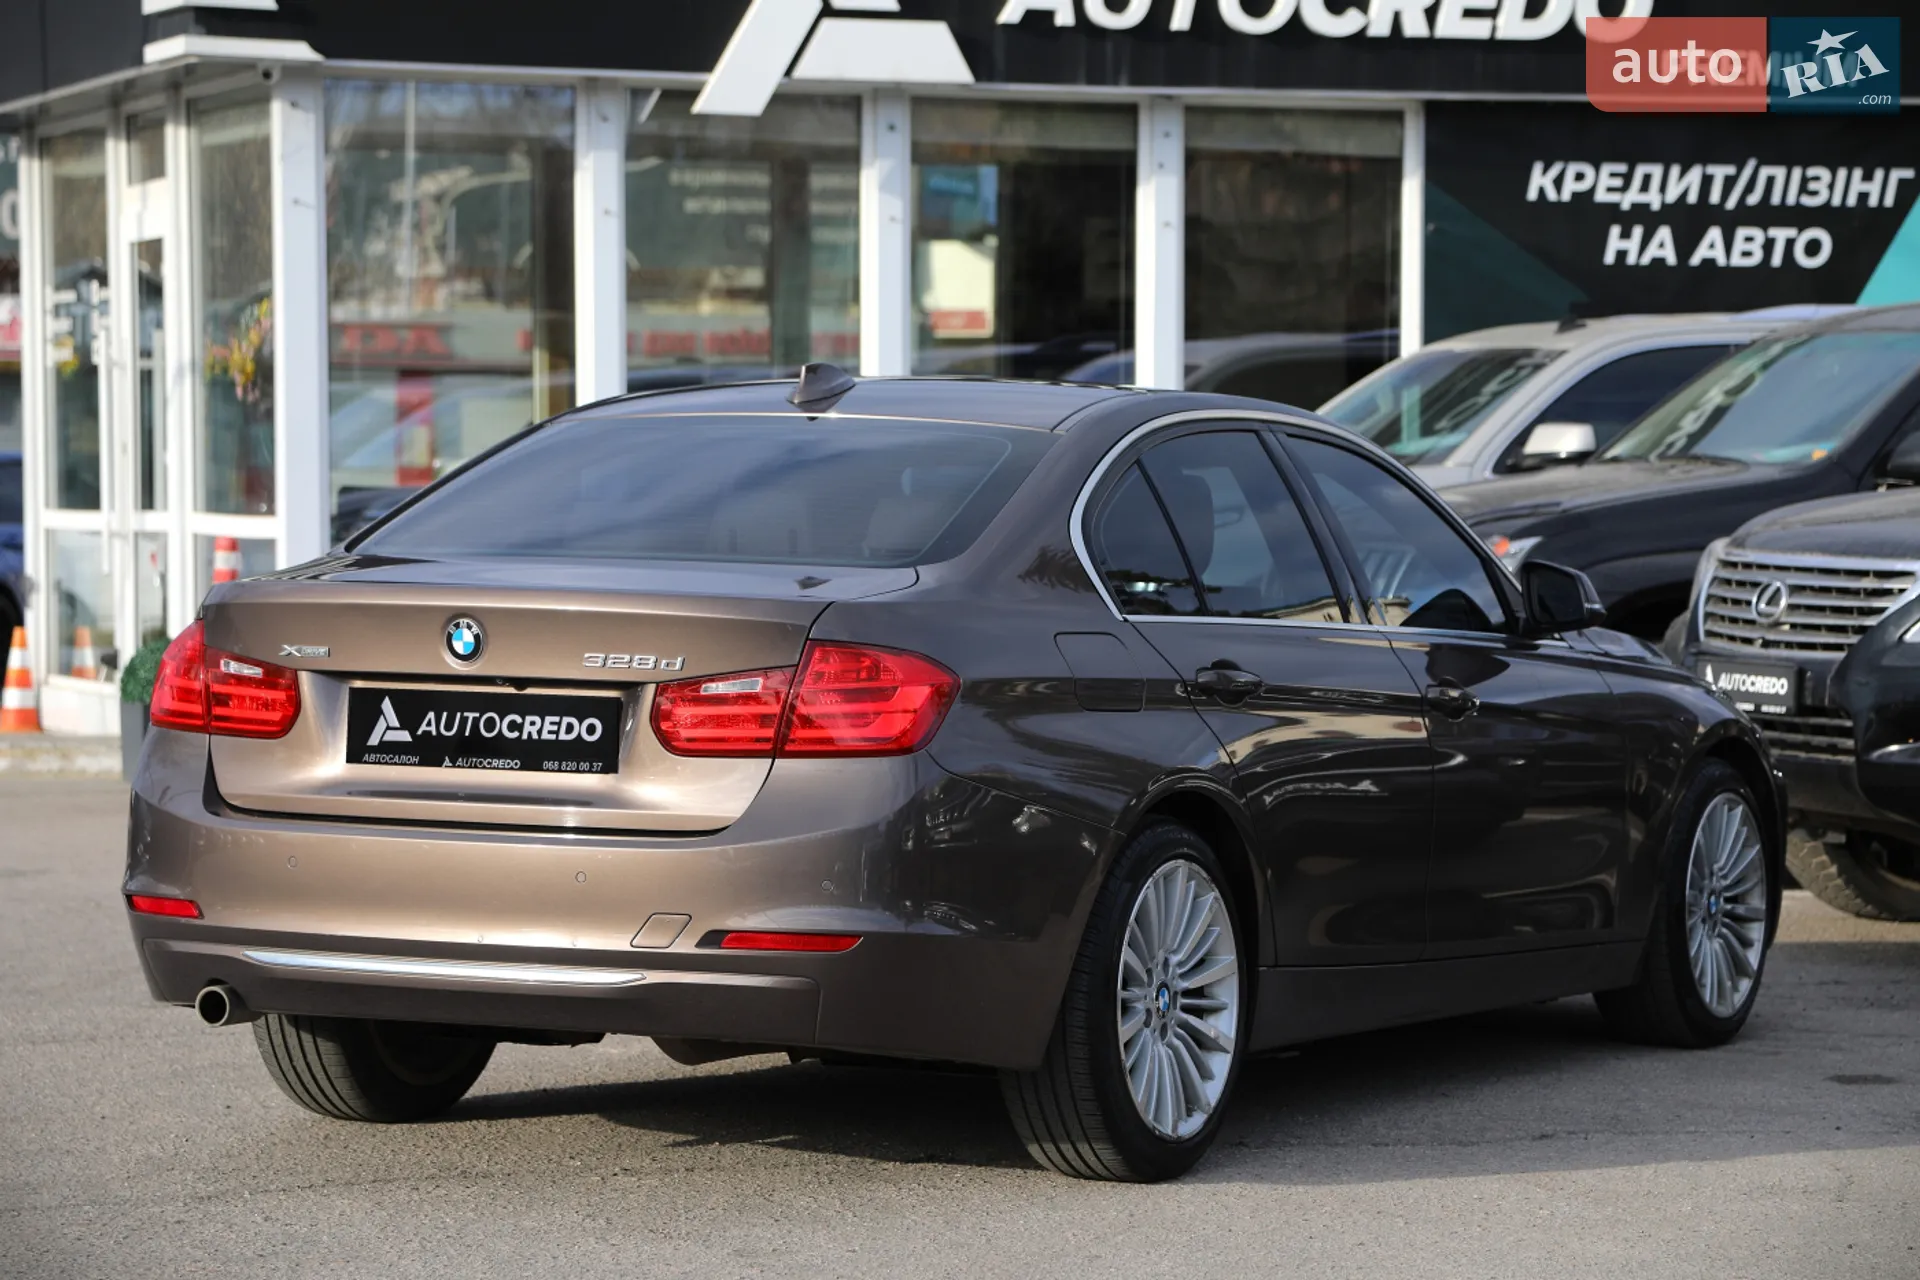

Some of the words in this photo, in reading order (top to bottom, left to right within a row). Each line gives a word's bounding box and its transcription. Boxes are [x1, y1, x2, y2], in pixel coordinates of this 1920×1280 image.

[1525, 157, 1916, 211] КРЕДИТ/ЛІЗІНГ
[1602, 223, 1678, 266] НА
[1688, 224, 1834, 269] АВТО
[1718, 672, 1788, 695] AUTOCREDO
[416, 711, 603, 742] AUTOCREDO
[362, 753, 420, 765] АВТОСАЛОН
[455, 757, 521, 769] AUTOCREDO
[543, 761, 559, 771] 068
[561, 761, 577, 771] 820
[578, 762, 590, 771] 00
[592, 762, 603, 772] 37
